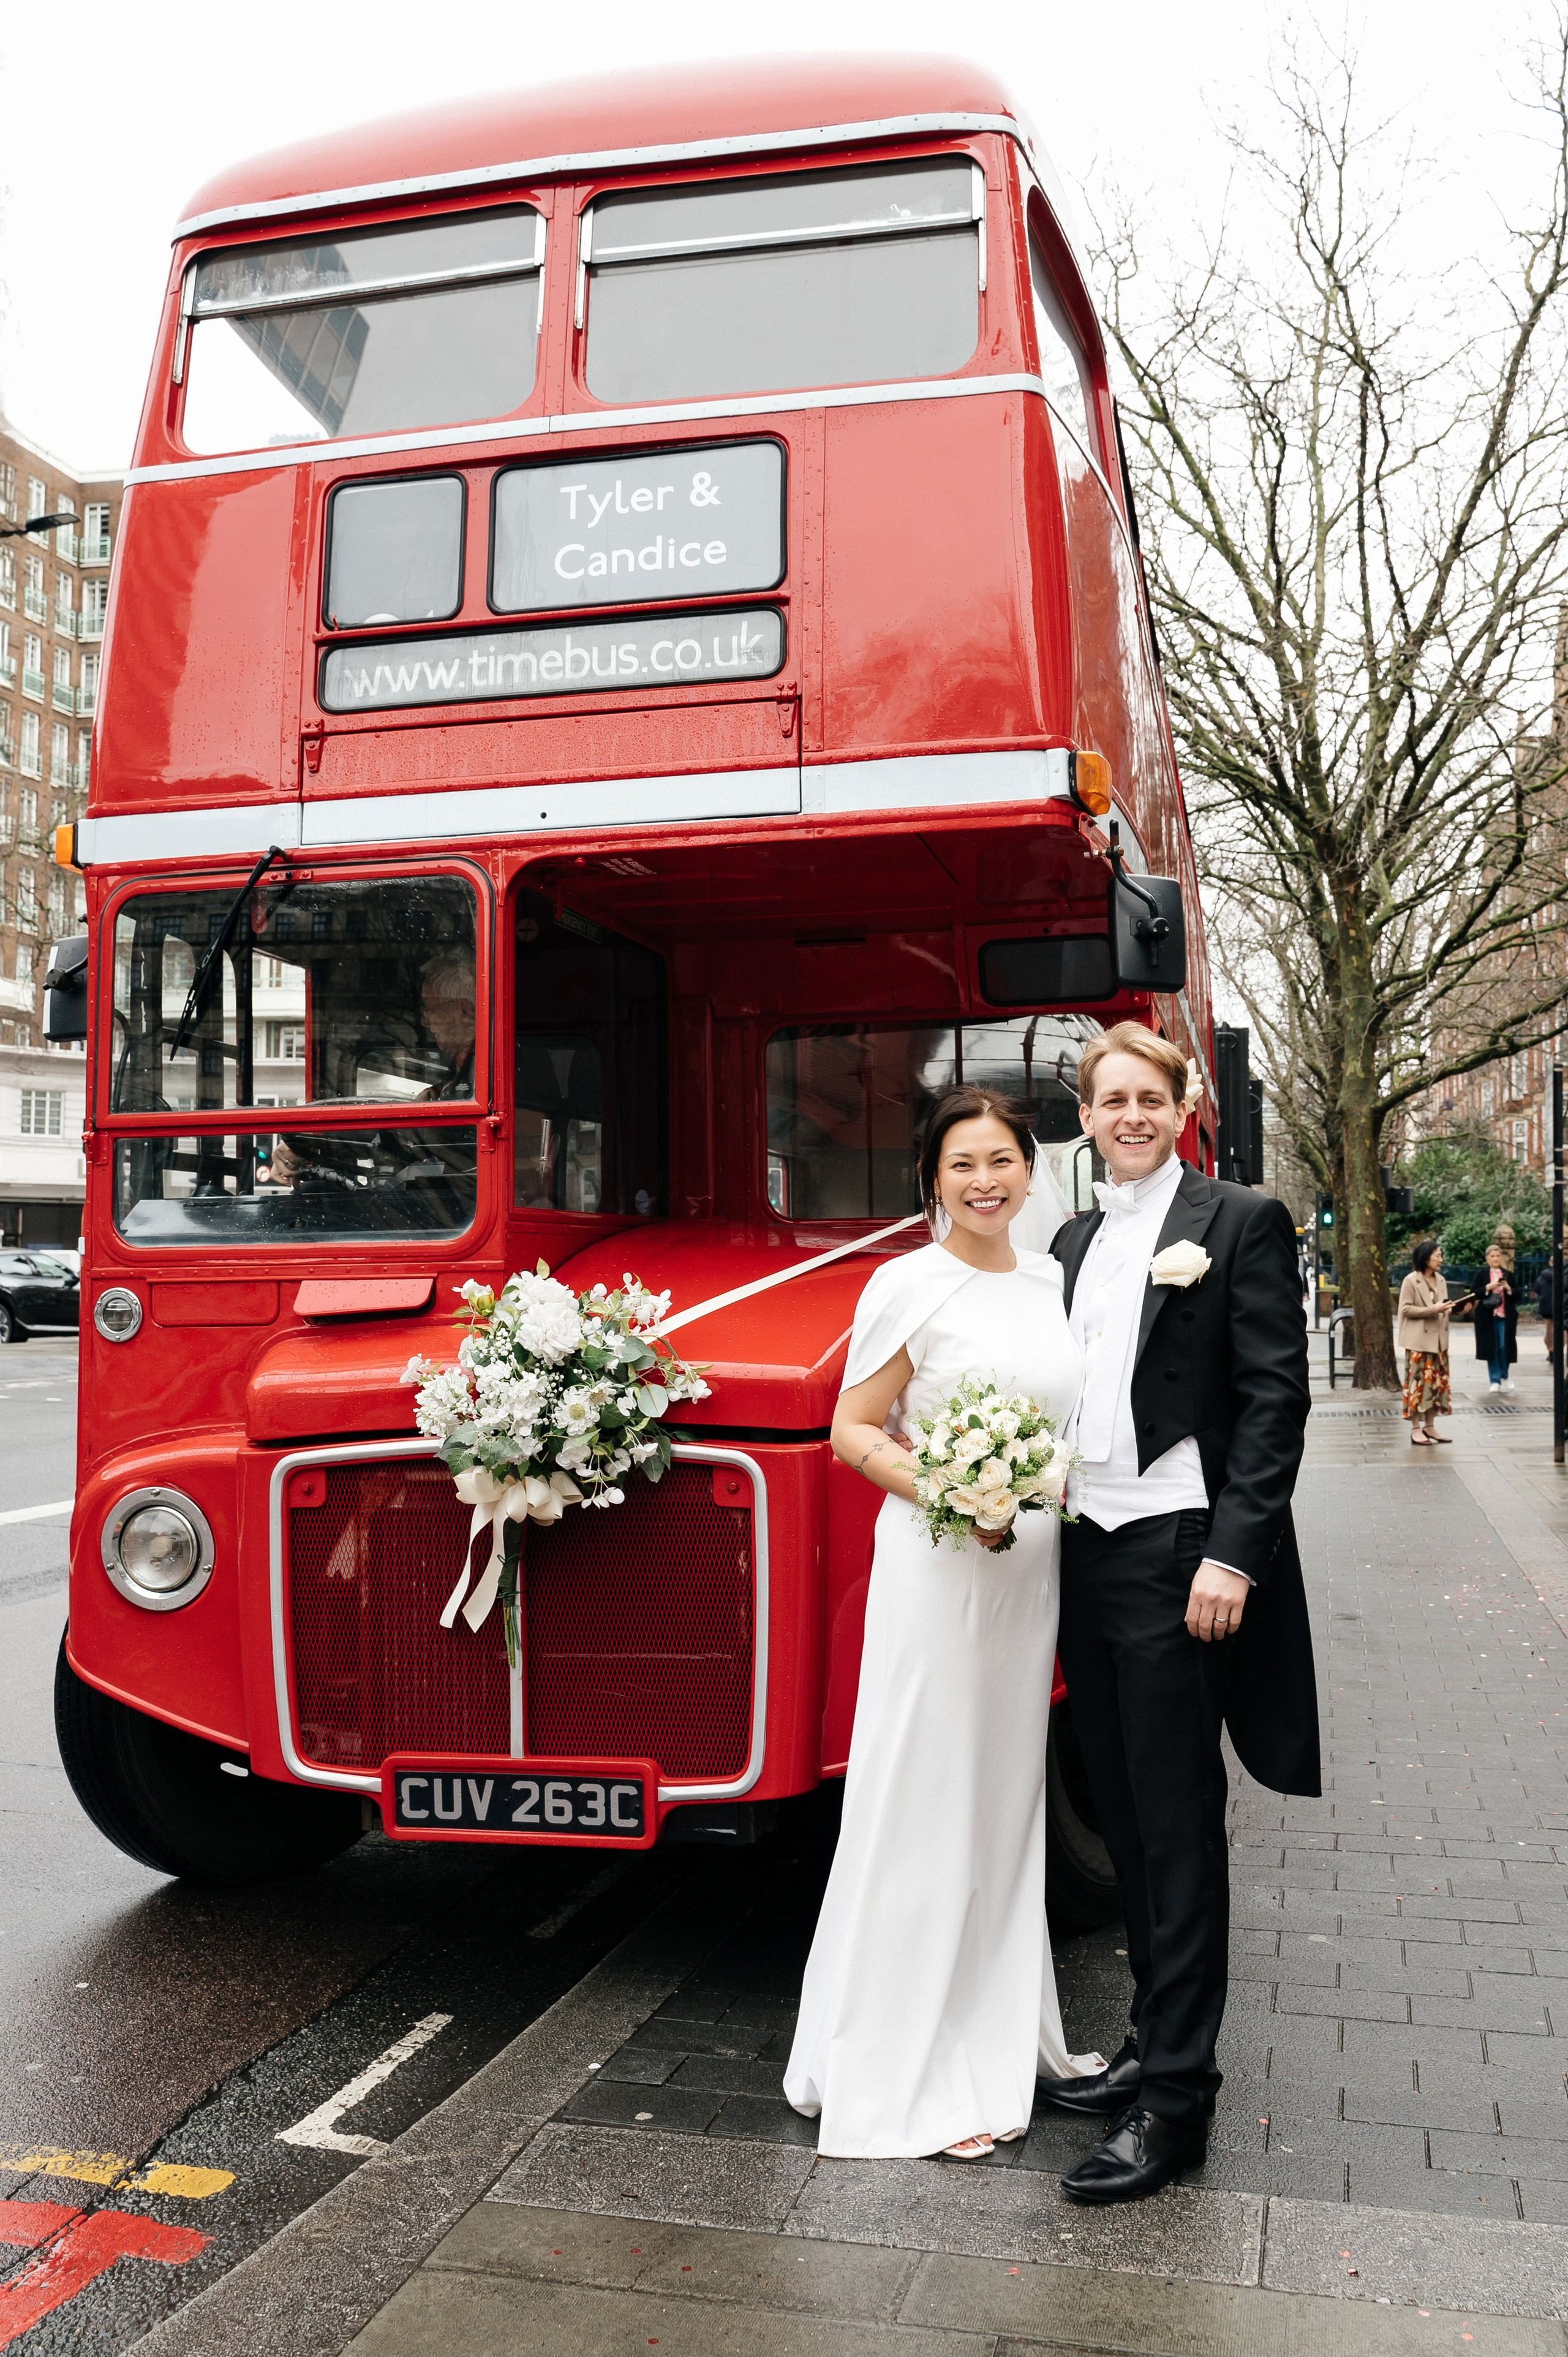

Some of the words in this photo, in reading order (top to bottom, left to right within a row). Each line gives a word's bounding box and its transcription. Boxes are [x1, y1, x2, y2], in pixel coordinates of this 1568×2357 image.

[560, 480, 674, 529] Tyler
[689, 471, 722, 507] &
[554, 535, 727, 579] Candice
[344, 620, 764, 698] www.timebus.co.uk
[401, 1777, 494, 1821] CUV
[511, 1780, 639, 1827] 263C
